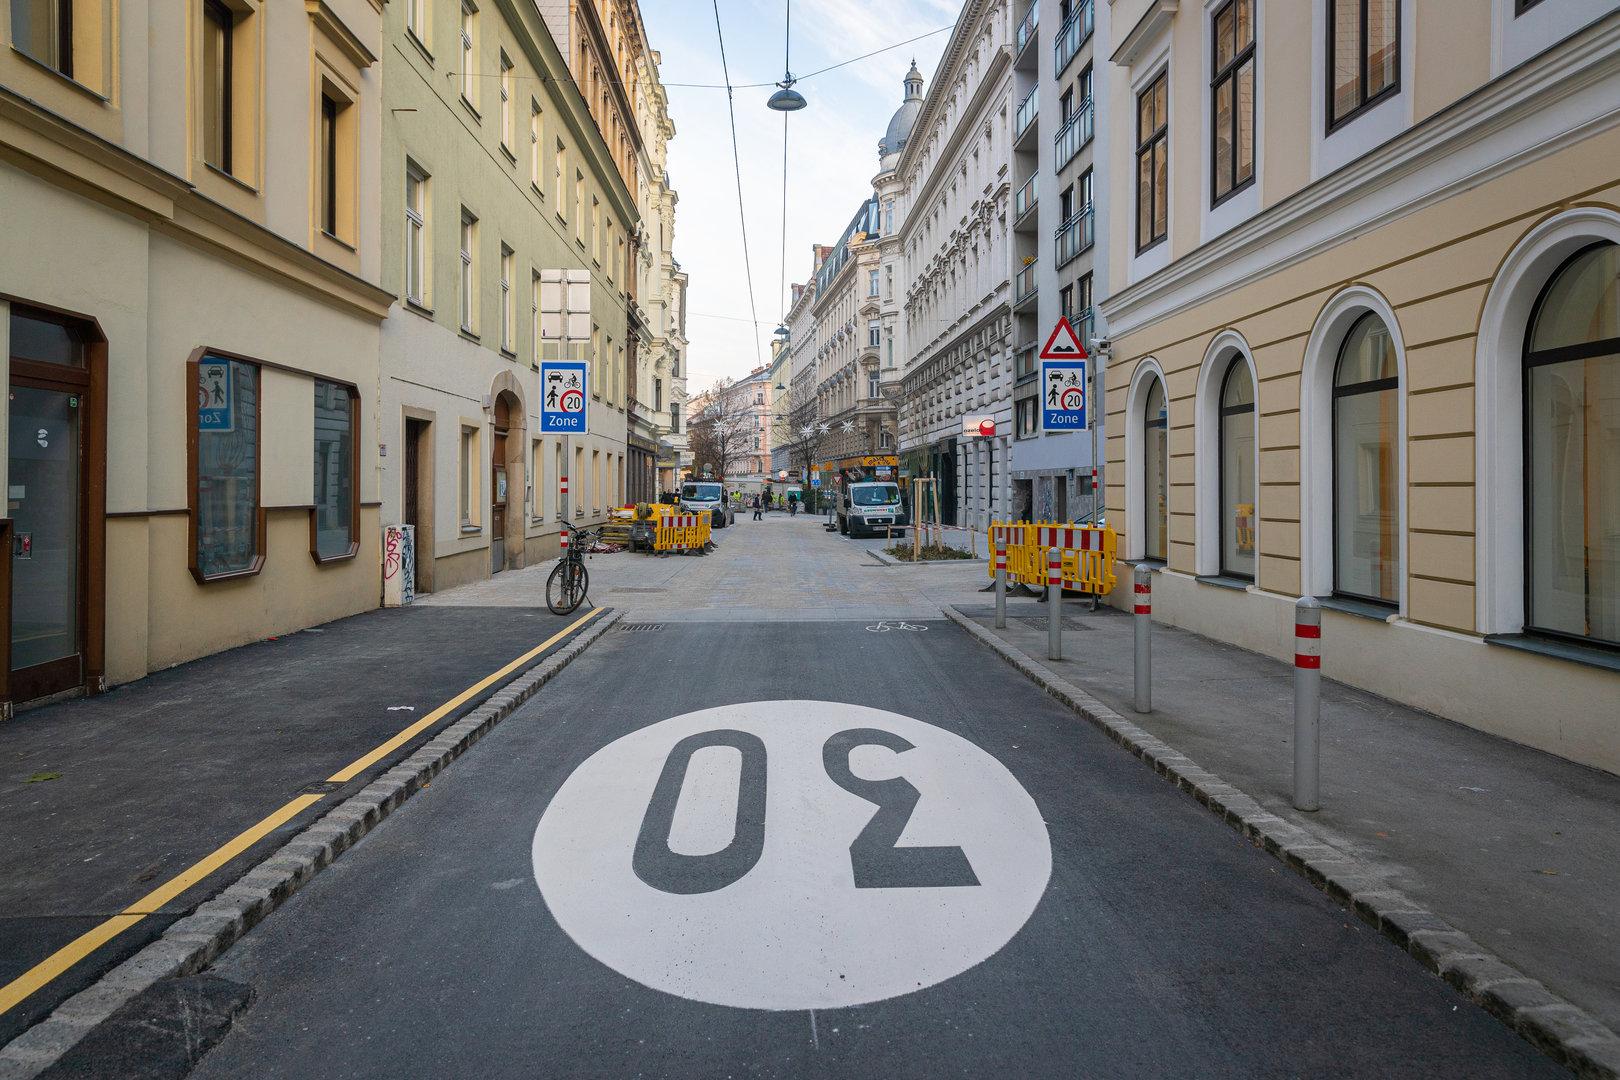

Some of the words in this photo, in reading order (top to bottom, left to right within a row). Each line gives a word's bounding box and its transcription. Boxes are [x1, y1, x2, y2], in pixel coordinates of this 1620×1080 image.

[567, 396, 580, 409] 20
[1067, 395, 1080, 407] 20
[549, 415, 578, 426] Zone
[1050, 413, 1079, 424] Zone
